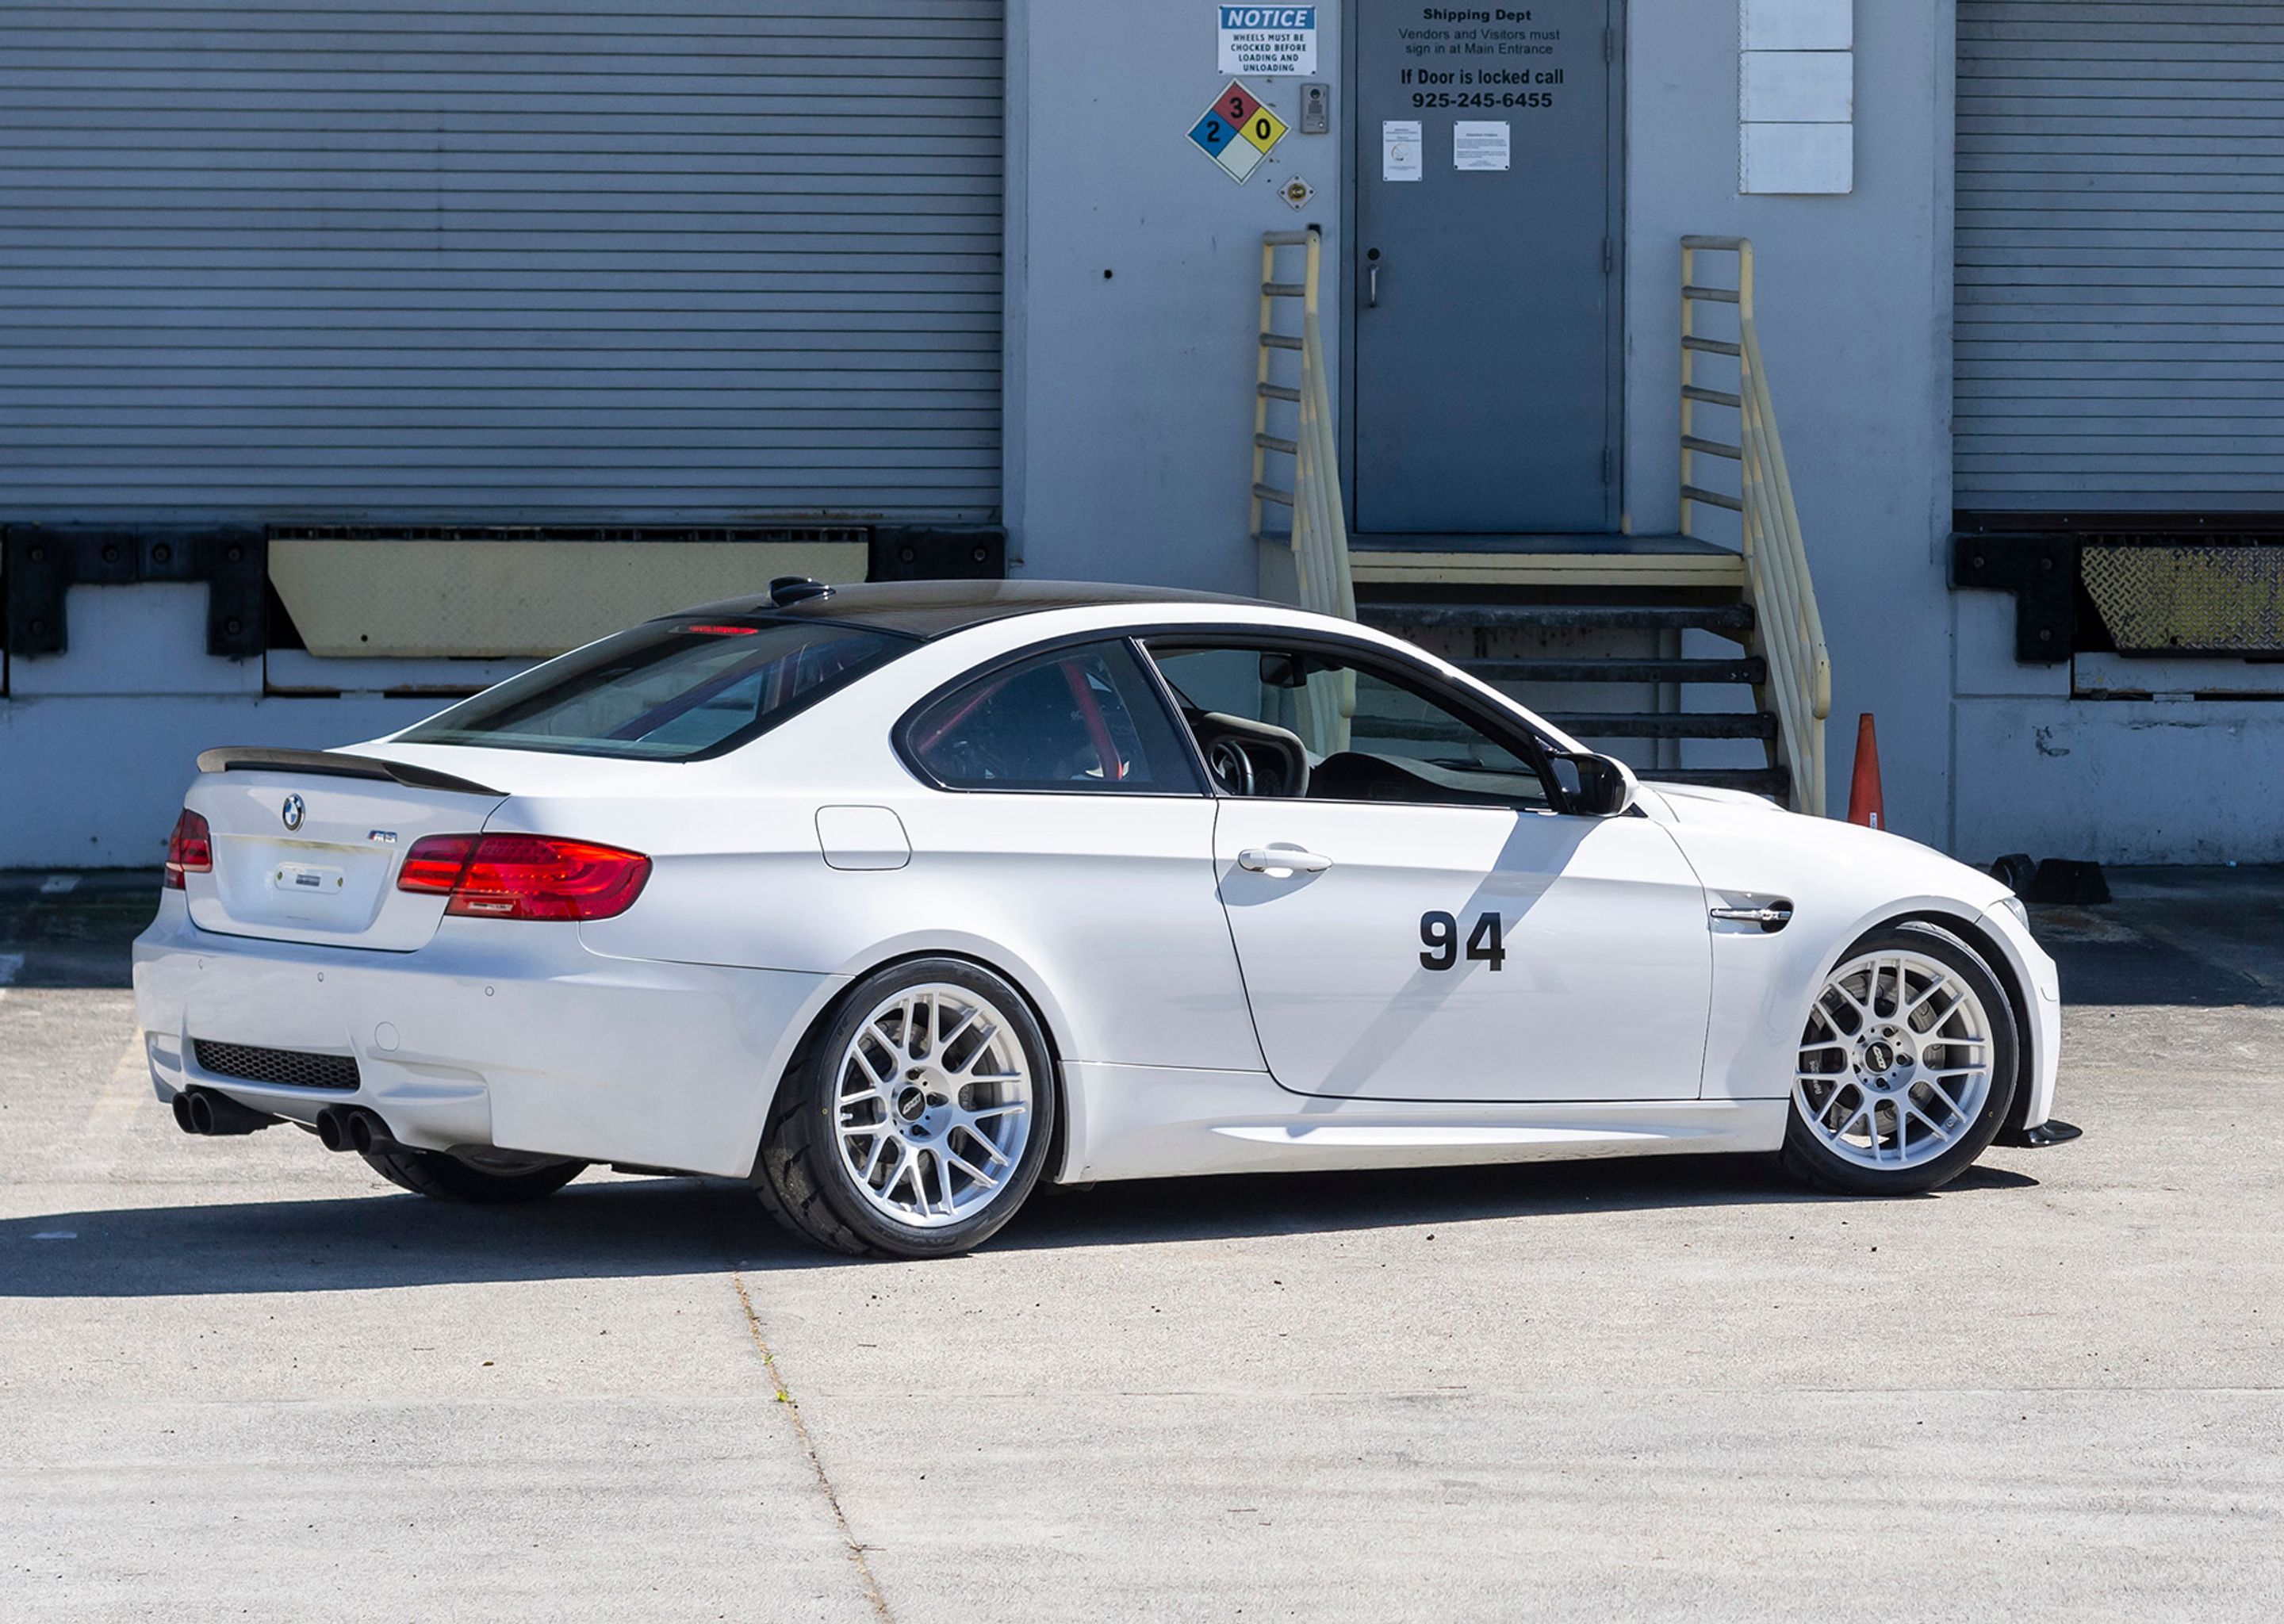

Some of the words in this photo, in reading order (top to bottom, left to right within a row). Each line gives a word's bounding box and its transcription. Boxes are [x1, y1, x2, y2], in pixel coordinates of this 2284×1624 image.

[1228, 10, 1307, 27] NOTICE
[1424, 8, 1490, 22] Shipping
[1496, 9, 1531, 22] Dept
[1398, 29, 1450, 40] Vendors
[1454, 29, 1477, 40] and
[1481, 29, 1525, 40] Visitors
[1530, 29, 1560, 40] must
[1405, 44, 1430, 56] sign
[1435, 44, 1445, 54] in
[1450, 44, 1461, 54] at
[1465, 43, 1494, 54] Main
[1499, 43, 1553, 55] Entrance
[1401, 69, 1412, 84] If
[1418, 69, 1454, 84] Door
[1460, 69, 1473, 84] is
[1478, 69, 1530, 84] locked
[1535, 69, 1564, 84] call
[1230, 97, 1244, 119] 3
[1412, 92, 1553, 108] 925-245-6455
[1207, 121, 1220, 143] 2
[1255, 118, 1270, 140] 0
[1420, 910, 1505, 971] 94
